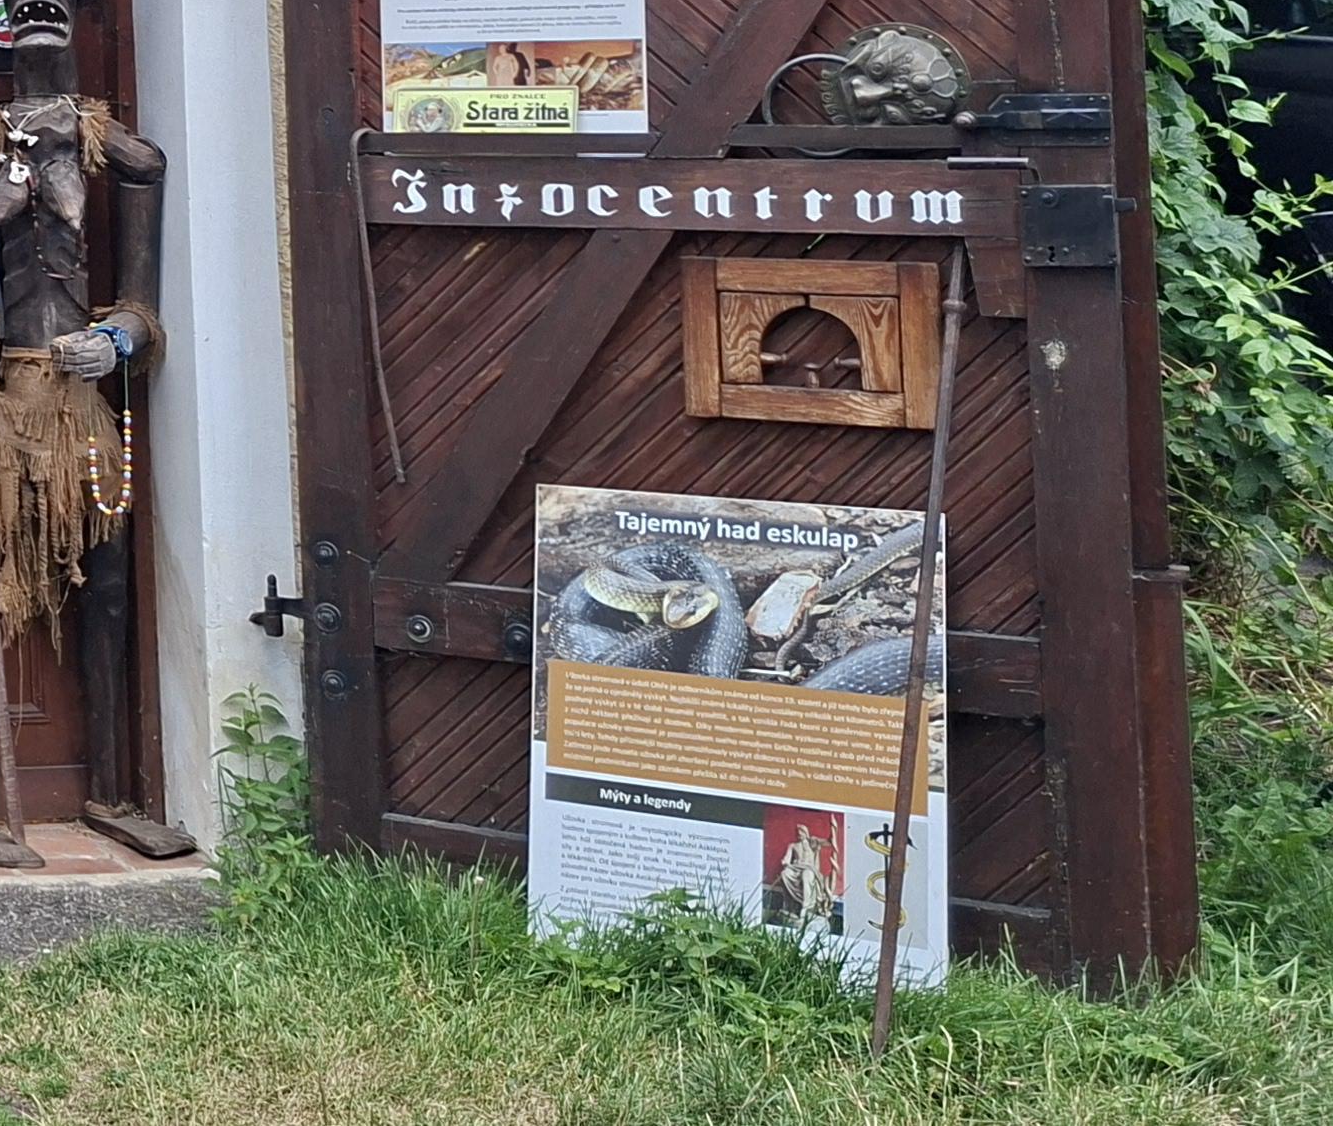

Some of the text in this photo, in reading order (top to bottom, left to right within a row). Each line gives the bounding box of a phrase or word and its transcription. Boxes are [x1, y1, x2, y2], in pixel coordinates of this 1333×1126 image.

[466, 101, 570, 121] Stará žitná
[391, 169, 965, 224] Infocentrum
[615, 510, 859, 553] Tajemný had eskulap
[599, 787, 692, 813] Mýty a legendy
